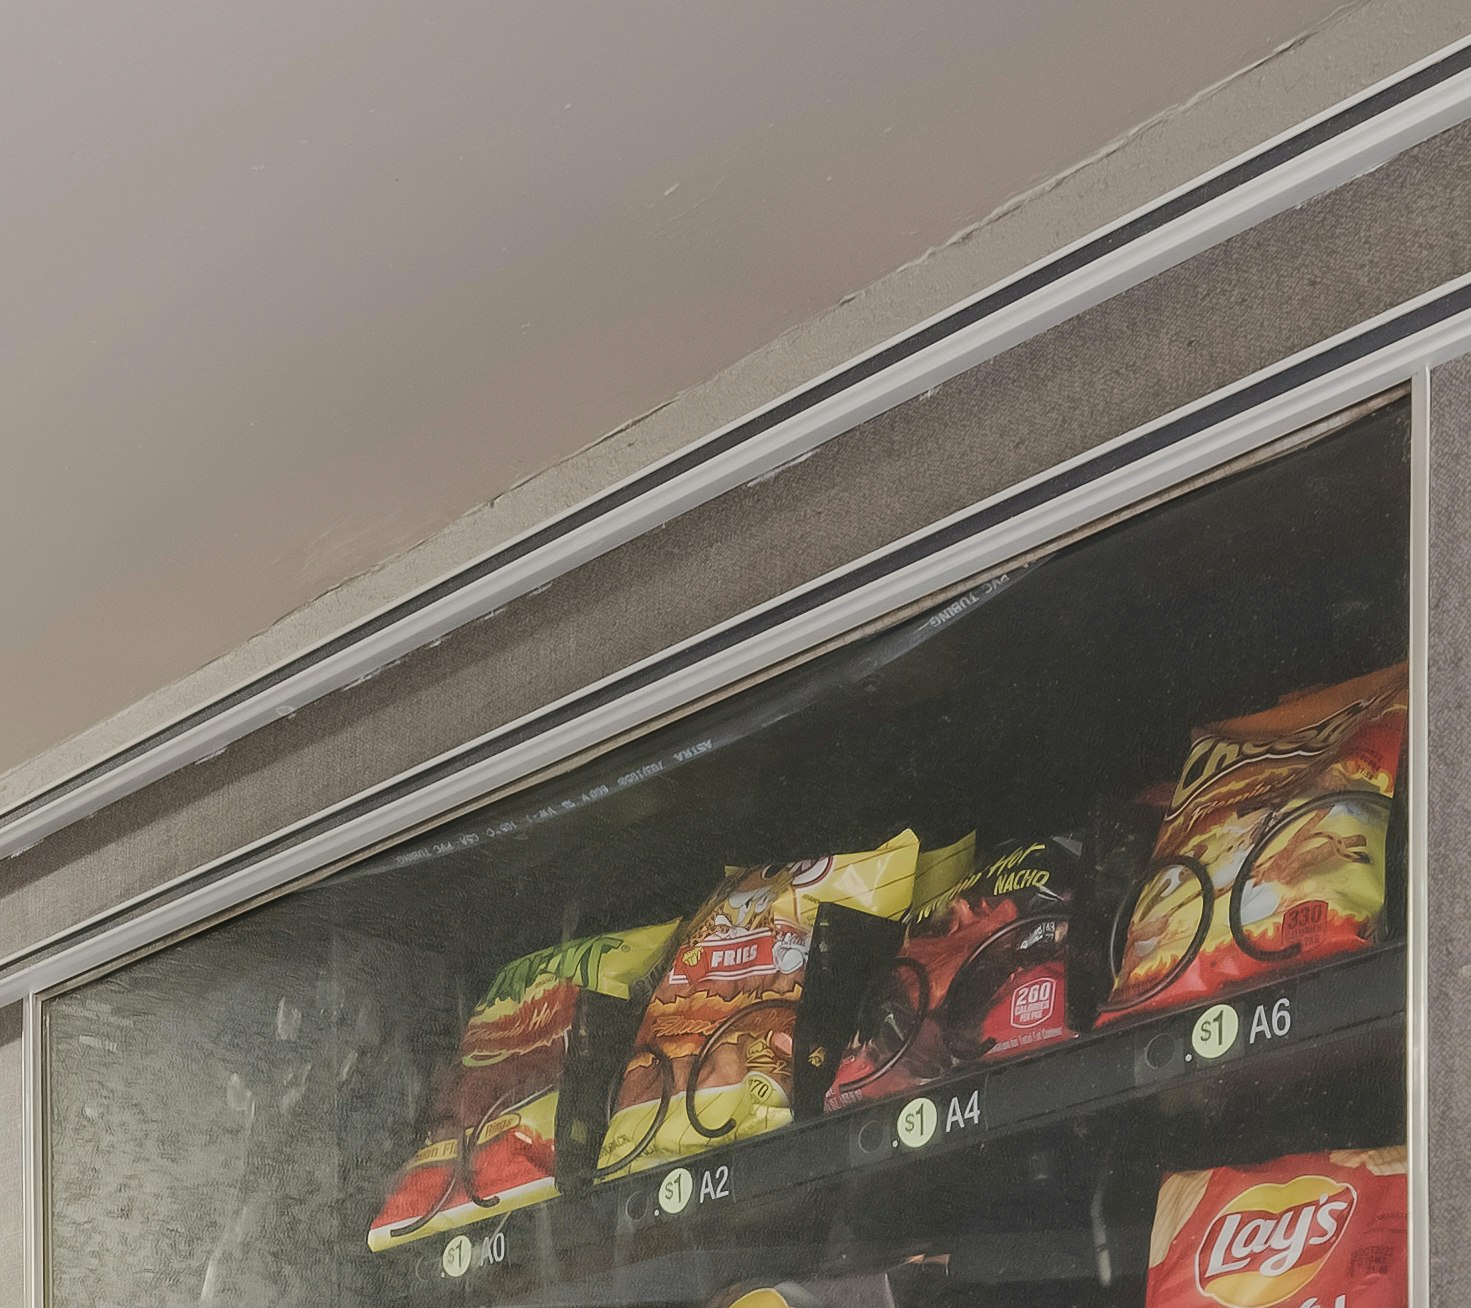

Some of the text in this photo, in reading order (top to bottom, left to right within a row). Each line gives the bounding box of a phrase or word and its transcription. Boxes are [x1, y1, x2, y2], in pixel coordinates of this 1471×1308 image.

[993, 870, 1050, 896] NACHO
[1287, 908, 1324, 930] 330
[710, 943, 760, 968] FRIES
[1015, 981, 1050, 1006] 260
[1200, 998, 1292, 1046] $1 A6
[904, 1090, 981, 1137] $1 A4
[664, 1165, 730, 1204] $1 A2
[447, 1233, 505, 1267] $1 A0
[1204, 1193, 1348, 1278] Lay's
